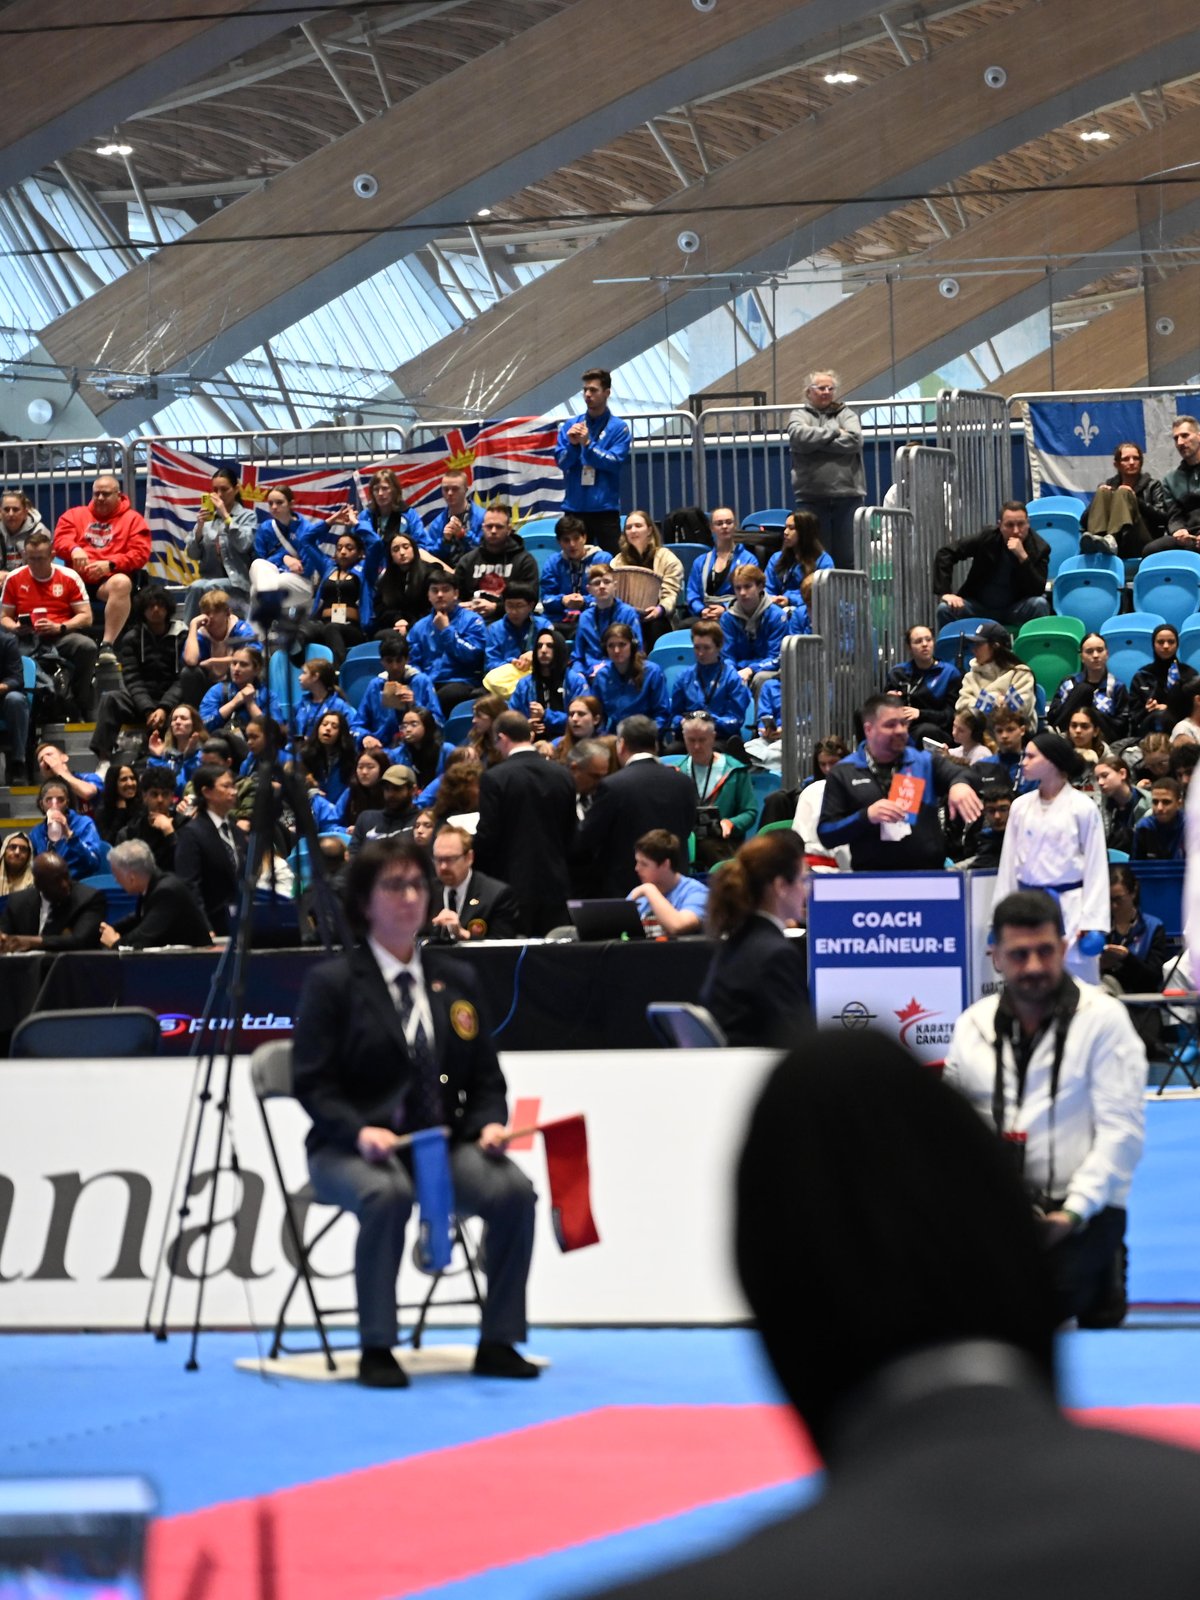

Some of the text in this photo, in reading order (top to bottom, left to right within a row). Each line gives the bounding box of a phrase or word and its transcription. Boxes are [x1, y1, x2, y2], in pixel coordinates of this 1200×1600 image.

[852, 911, 922, 928] COACH
[815, 934, 957, 954] ENTRAÎNEUR·E
[916, 1035, 951, 1045] CANAD
